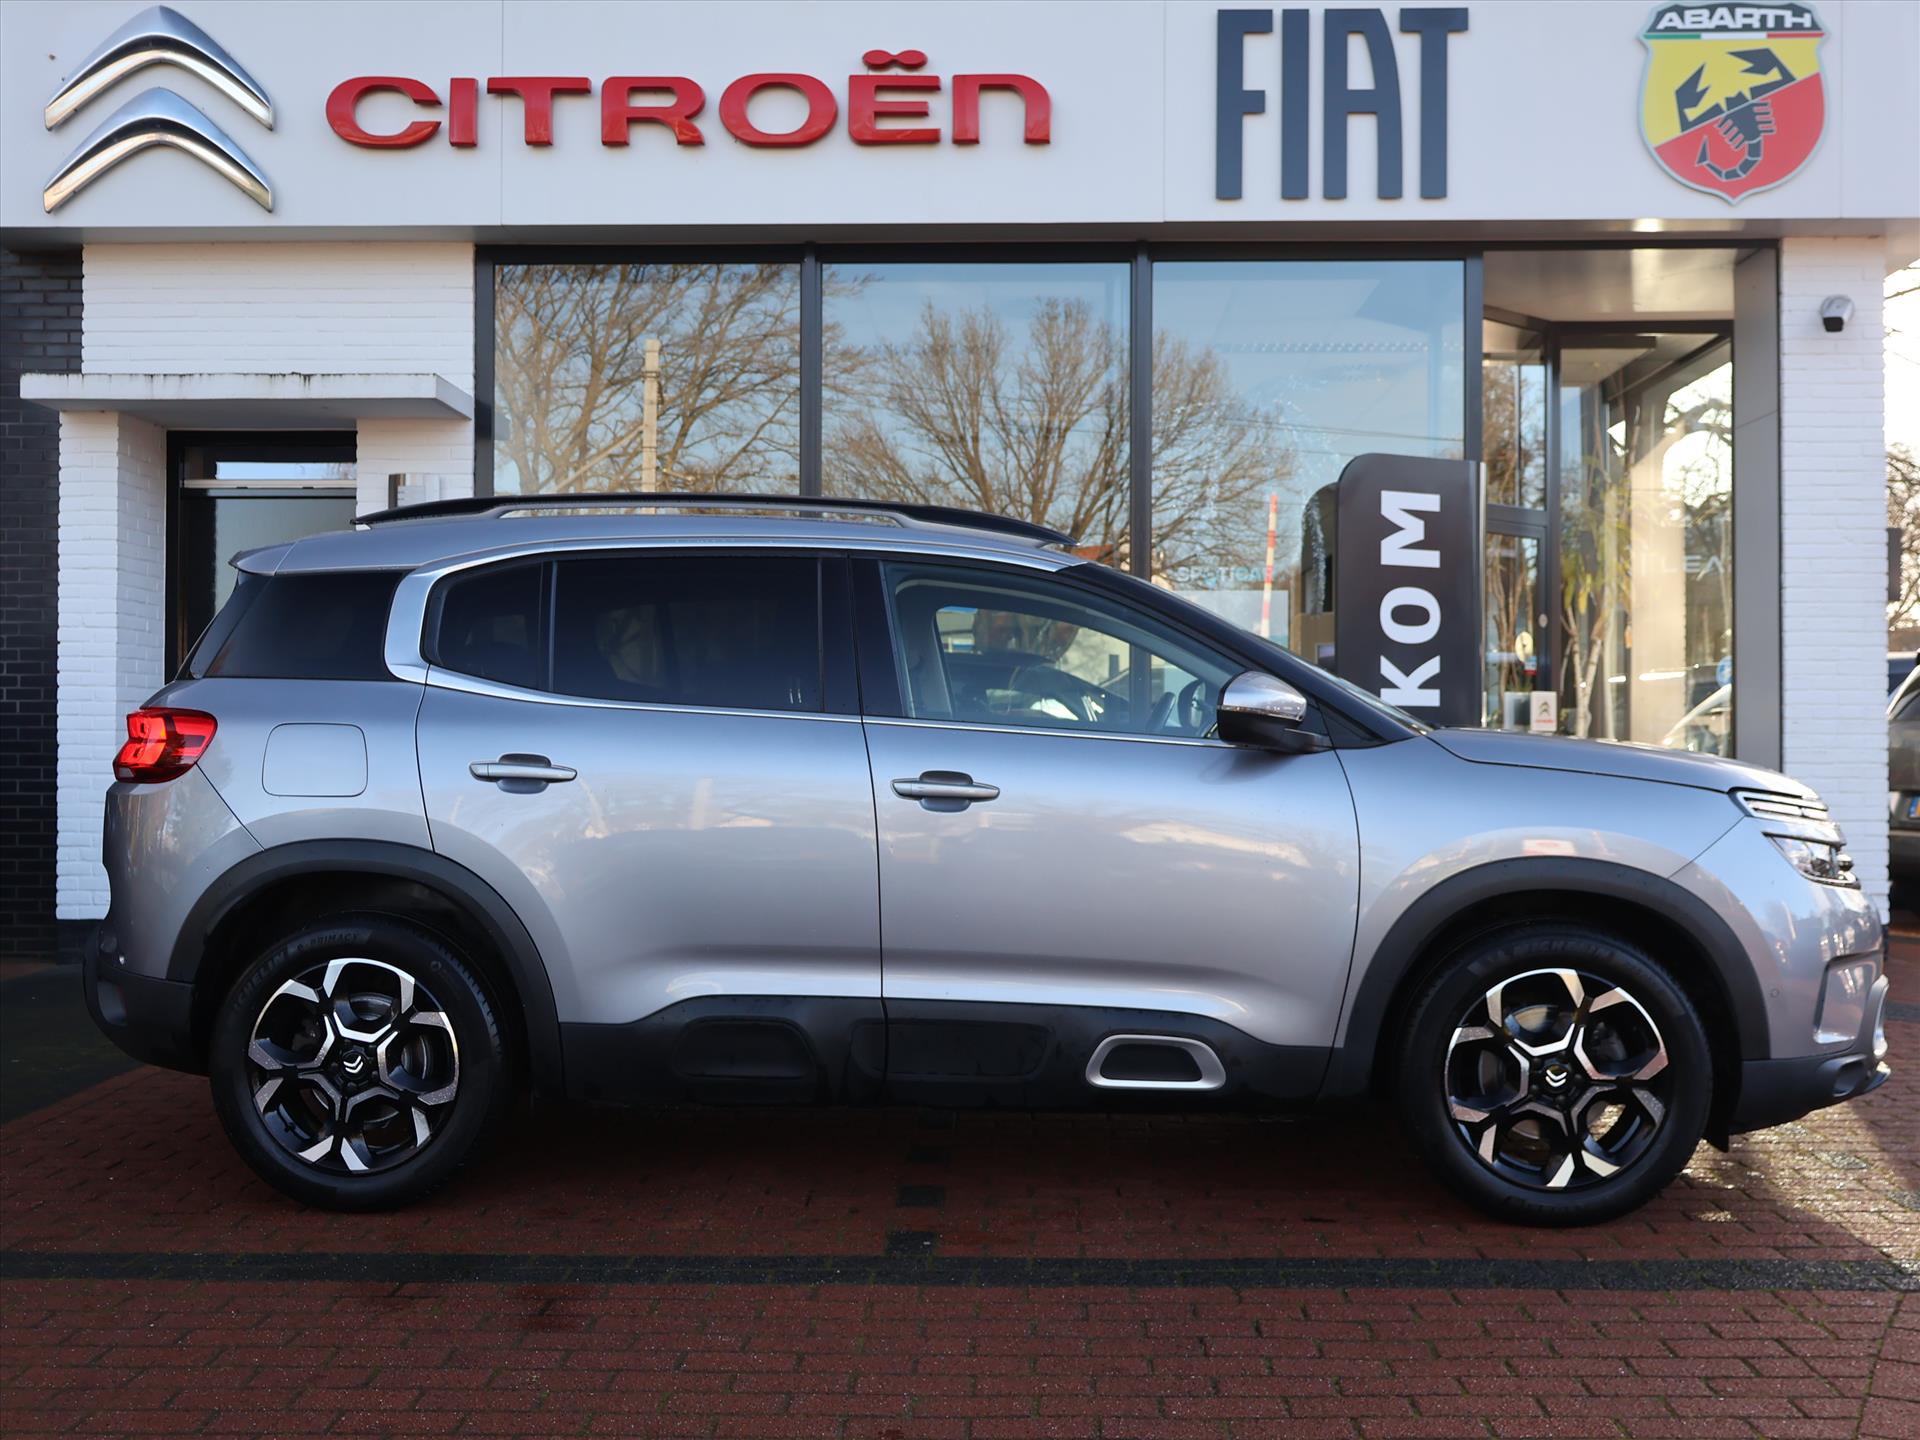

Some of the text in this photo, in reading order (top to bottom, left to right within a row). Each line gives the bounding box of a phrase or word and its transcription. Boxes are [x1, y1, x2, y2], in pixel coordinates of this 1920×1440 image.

[1655, 7, 1812, 30] ABARTH
[325, 49, 1052, 147] CITROËN
[1216, 8, 1469, 200] FIAT
